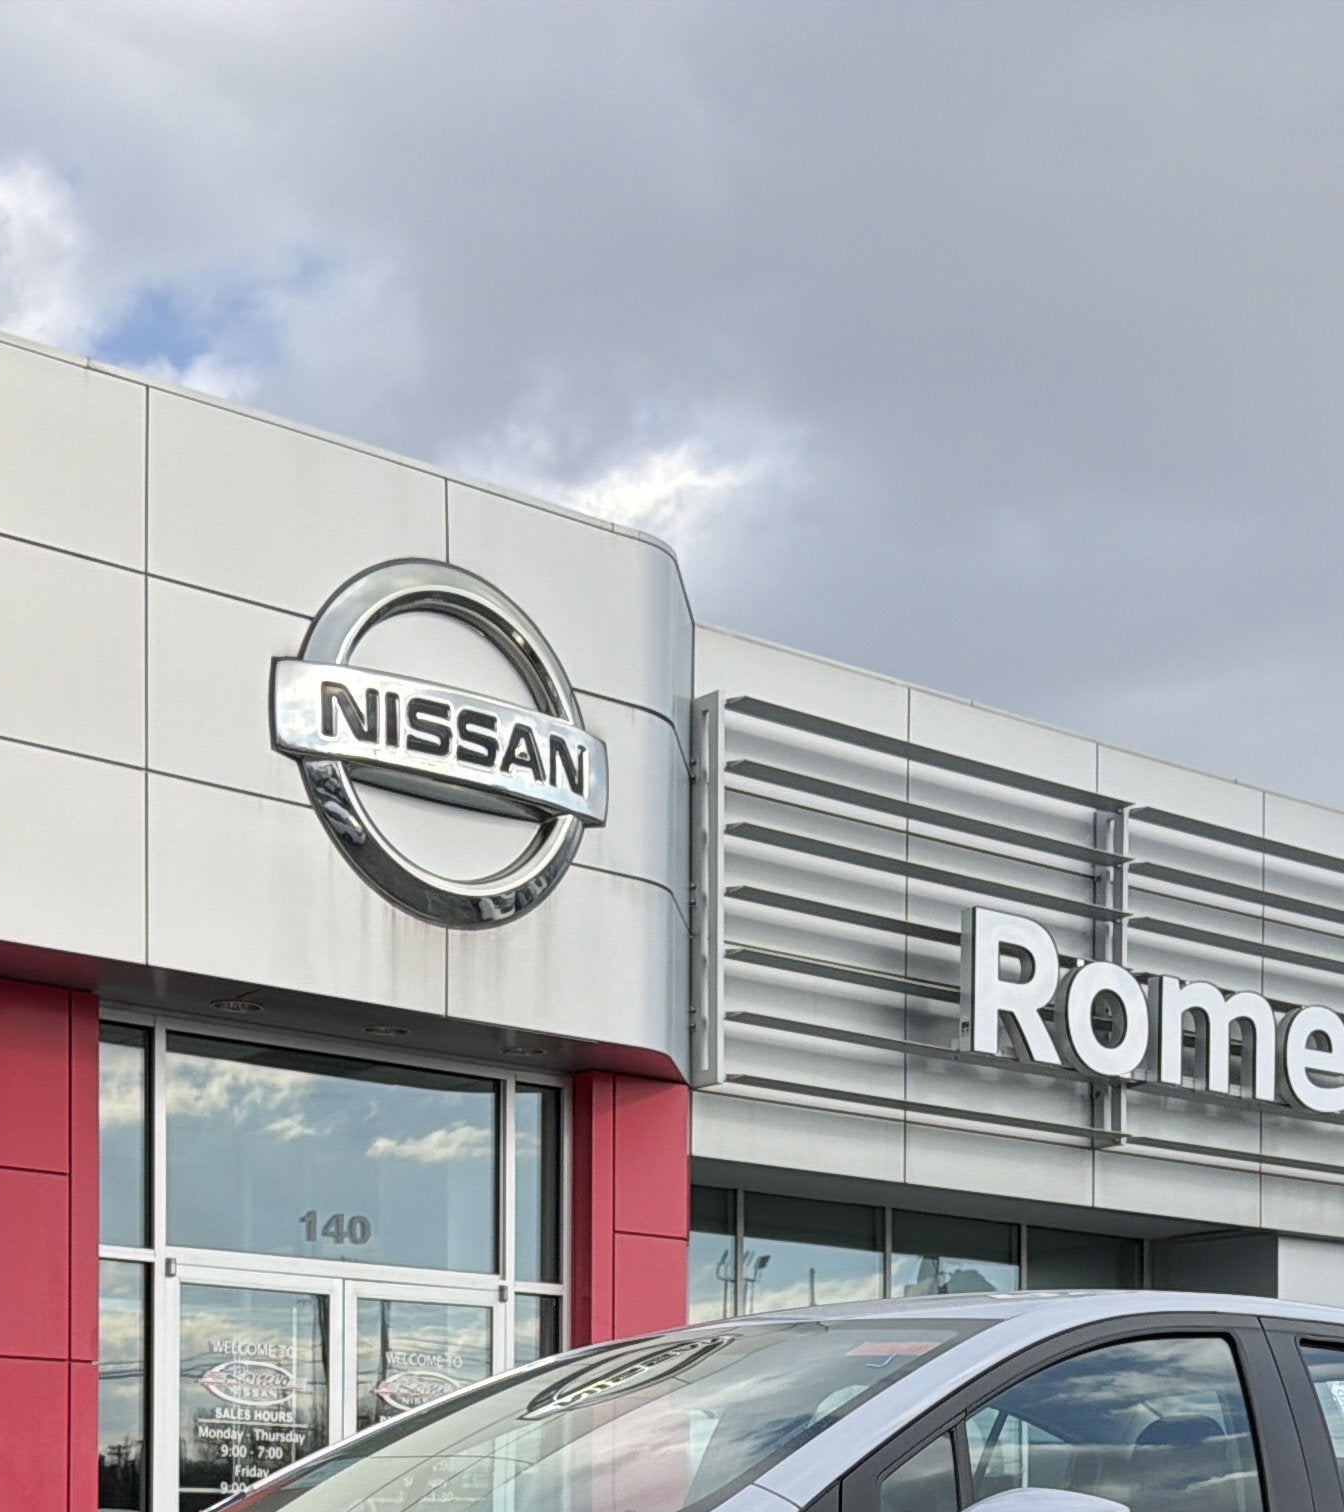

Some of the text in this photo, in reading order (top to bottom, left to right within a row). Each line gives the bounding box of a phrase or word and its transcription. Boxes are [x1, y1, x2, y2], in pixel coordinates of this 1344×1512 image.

[320, 680, 589, 798] NISSAN
[299, 1210, 371, 1245] 140
[212, 1341, 295, 1358] WELCOME TO
[386, 1351, 463, 1369] WELCOME TO
[215, 1407, 293, 1423] SALES HOURS
[198, 1426, 243, 1441] Monday
[254, 1428, 305, 1445] Thursday
[221, 1444, 247, 1458] 9:00
[257, 1446, 283, 1460] 7:00
[234, 1464, 270, 1478] Friday
